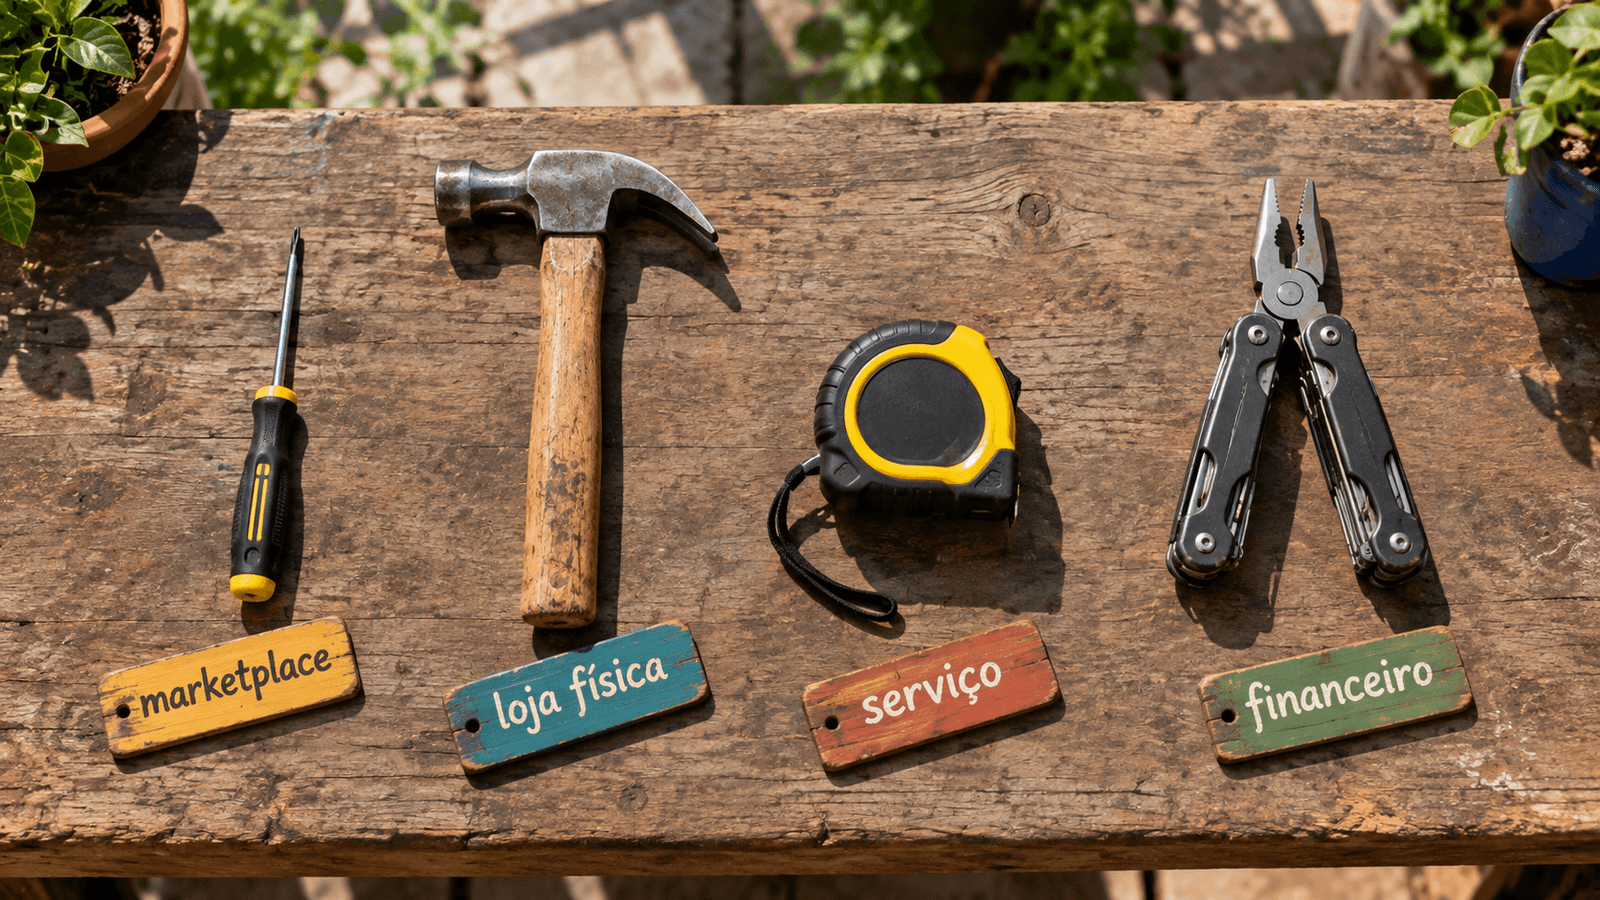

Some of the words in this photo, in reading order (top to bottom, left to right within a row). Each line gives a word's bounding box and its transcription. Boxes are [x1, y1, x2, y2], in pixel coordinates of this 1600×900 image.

[140, 649, 332, 718] marketplace
[493, 685, 562, 735] loja
[569, 657, 669, 717] física
[862, 661, 1002, 725] serviço
[1244, 658, 1433, 734] financeiro
